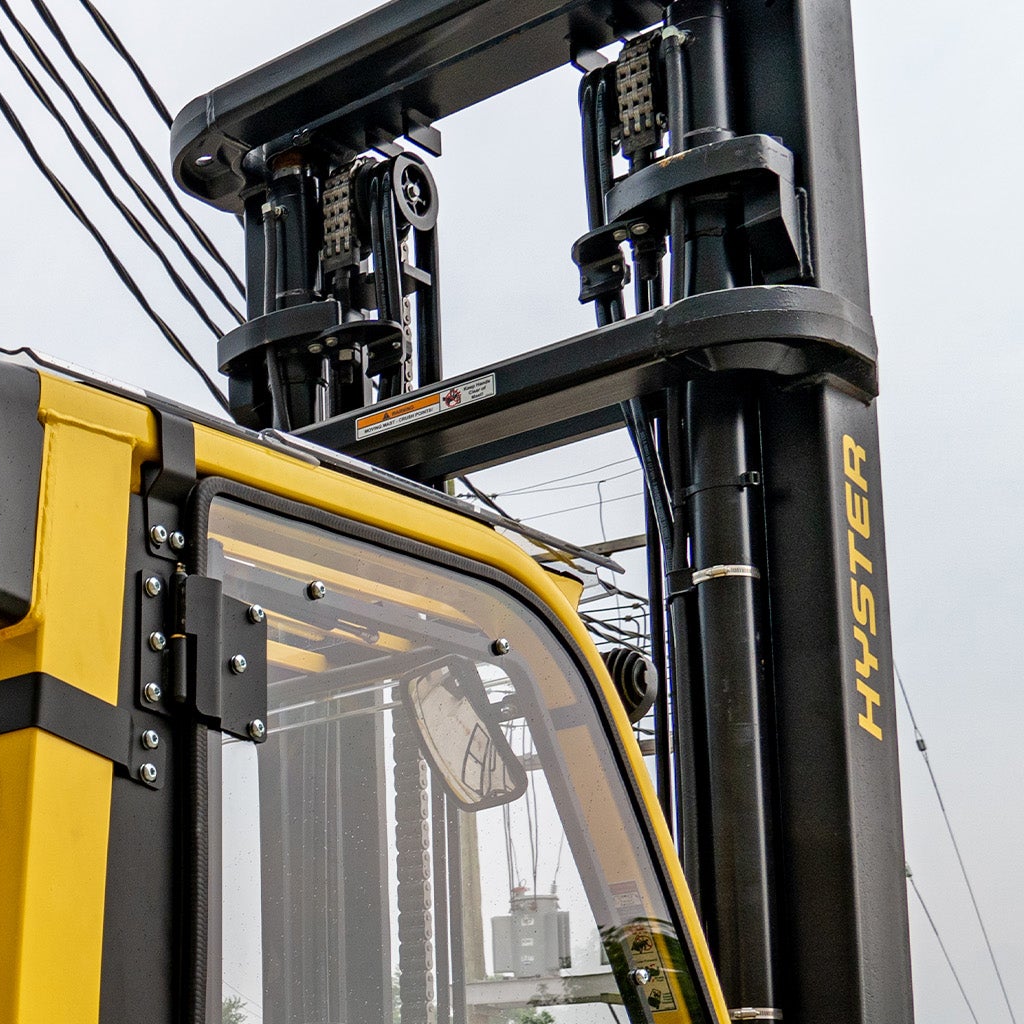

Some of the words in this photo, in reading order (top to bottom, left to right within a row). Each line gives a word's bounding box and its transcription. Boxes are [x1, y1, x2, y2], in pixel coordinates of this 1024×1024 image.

[364, 425, 382, 433] MOVING
[382, 419, 395, 428] MAST
[398, 412, 415, 423] CRUSH
[842, 434, 883, 741] HYSTER
